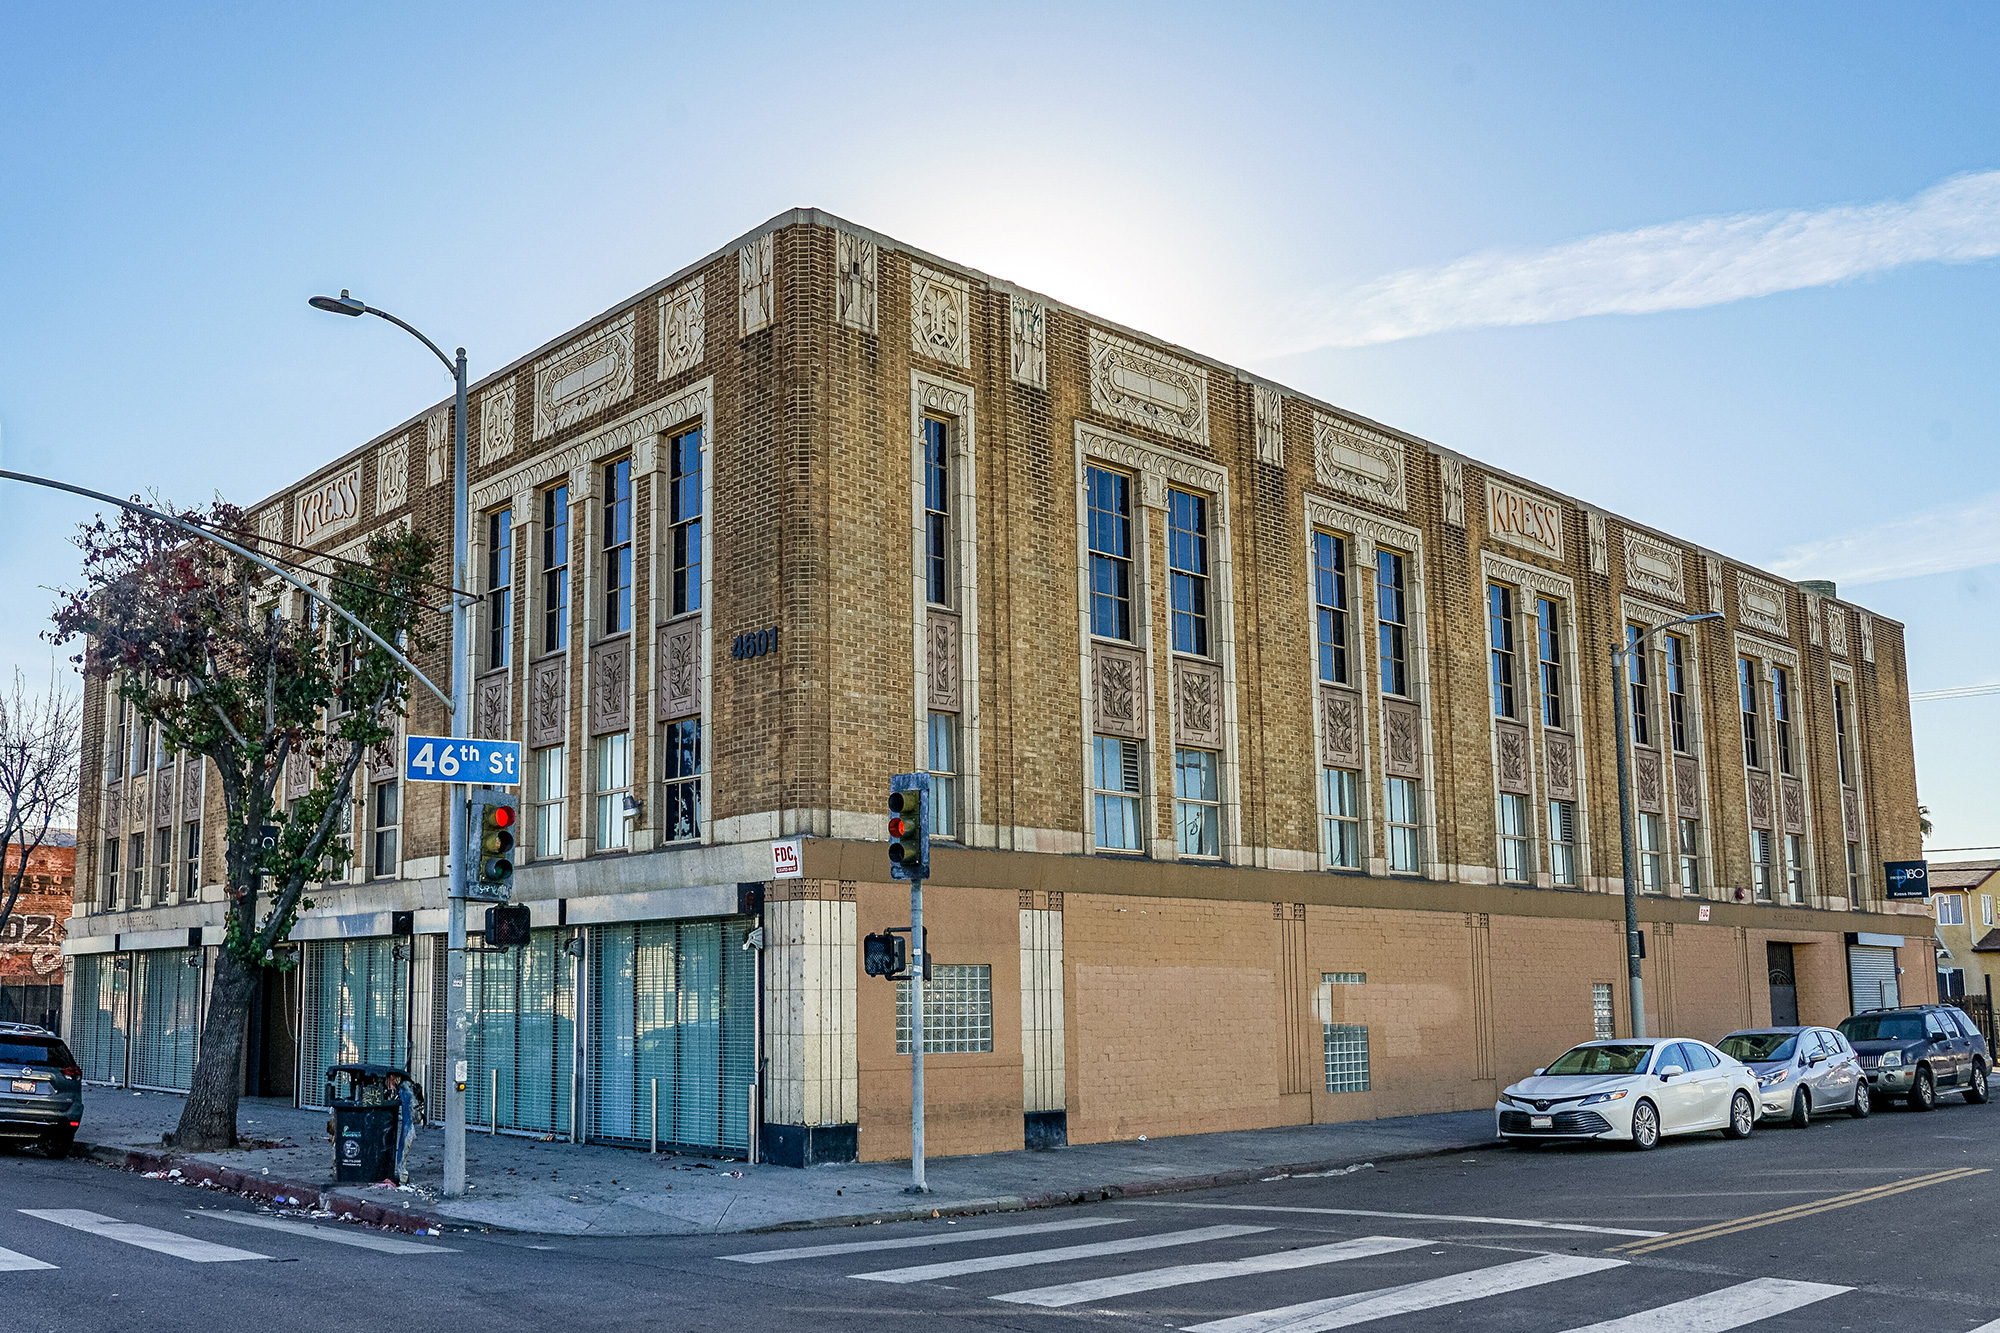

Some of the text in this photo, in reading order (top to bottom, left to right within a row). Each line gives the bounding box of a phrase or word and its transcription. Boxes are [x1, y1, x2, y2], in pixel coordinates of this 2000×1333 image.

[298, 471, 358, 545] KRESS
[1490, 486, 1556, 551] KRESS
[731, 625, 778, 660] 4601
[412, 743, 515, 776] 46th St
[774, 846, 794, 862] FDC
